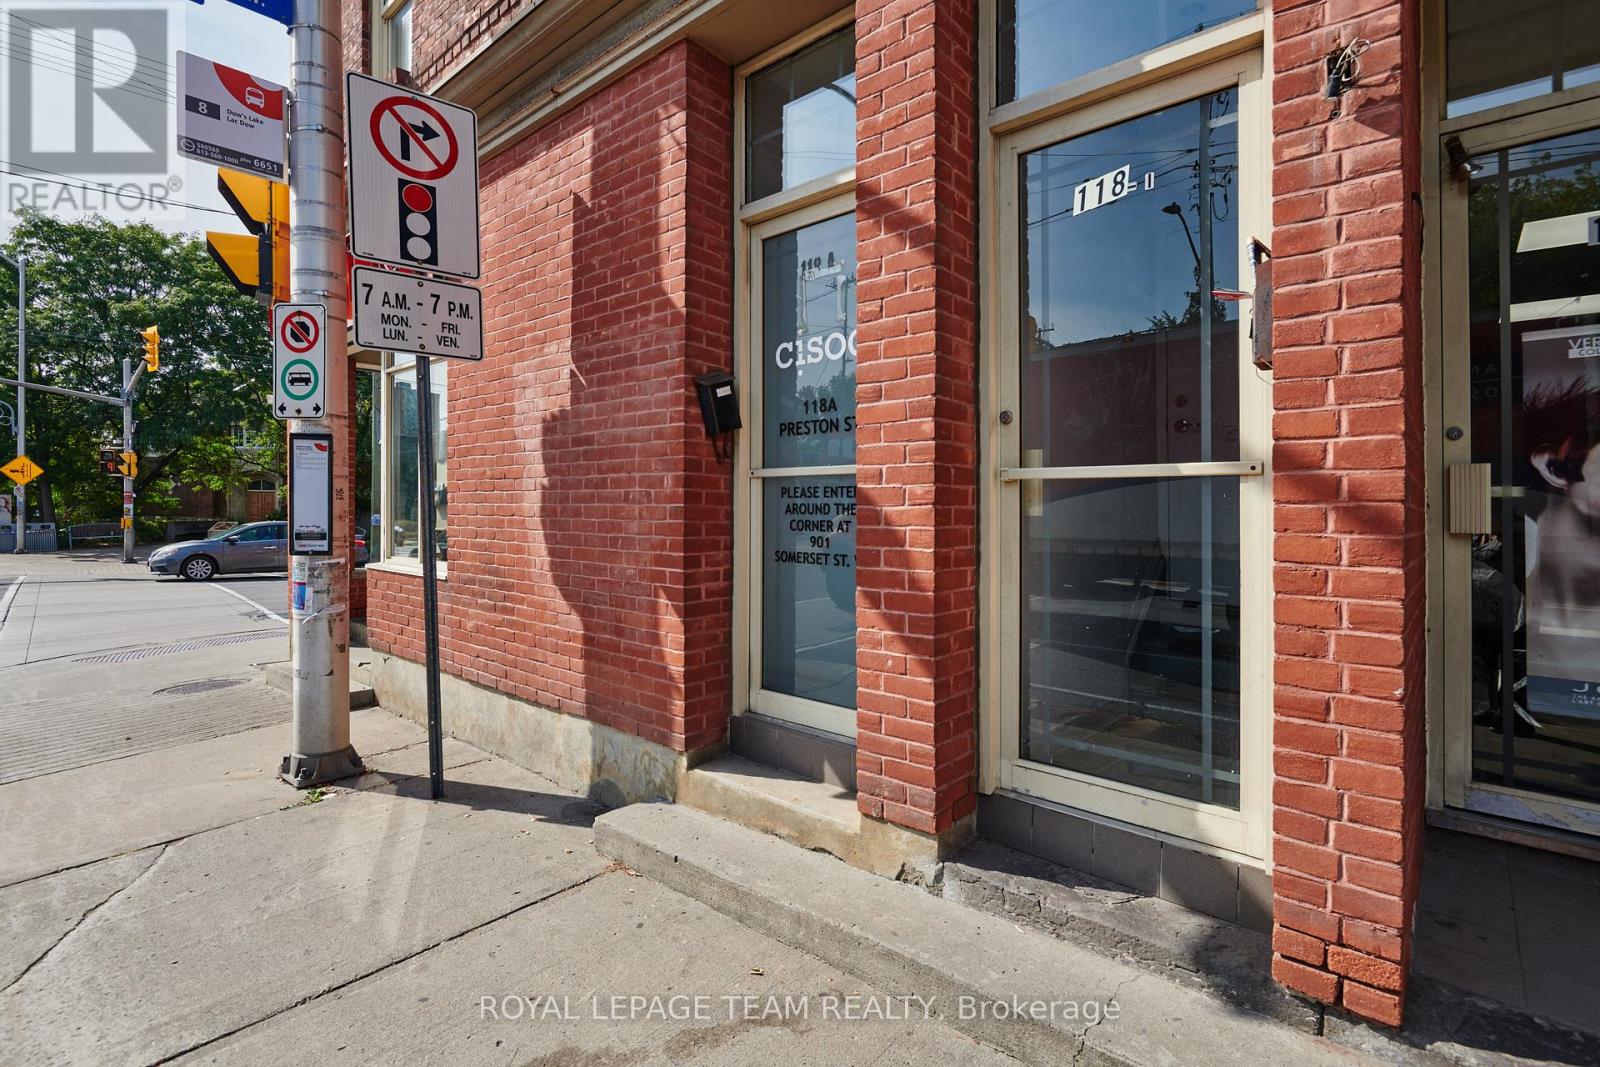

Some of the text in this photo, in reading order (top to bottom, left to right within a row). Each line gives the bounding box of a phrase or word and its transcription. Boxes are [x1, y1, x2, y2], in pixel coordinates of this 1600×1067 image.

[198, 101, 208, 114] 8
[227, 109, 264, 125] Dow's Lake
[227, 116, 255, 129] Lac Dow
[254, 159, 277, 171] 6651
[362, 283, 374, 305] 7
[382, 291, 411, 311] A.M.
[430, 293, 440, 314] 7
[448, 301, 474, 320] P.M.
[381, 313, 412, 328] MON.
[441, 322, 461, 335] FRI.
[383, 328, 408, 341] LUN.
[436, 335, 460, 348] VEN.
[803, 397, 838, 414] 118A
[779, 417, 839, 437] PRESTON
[781, 486, 820, 498] PLEASE
[785, 503, 857, 516] AROUND THE
[789, 519, 852, 533] CORNER AT
[810, 535, 830, 548] 901
[774, 550, 830, 566] SOMERSET
[833, 553, 850, 567] ST.
